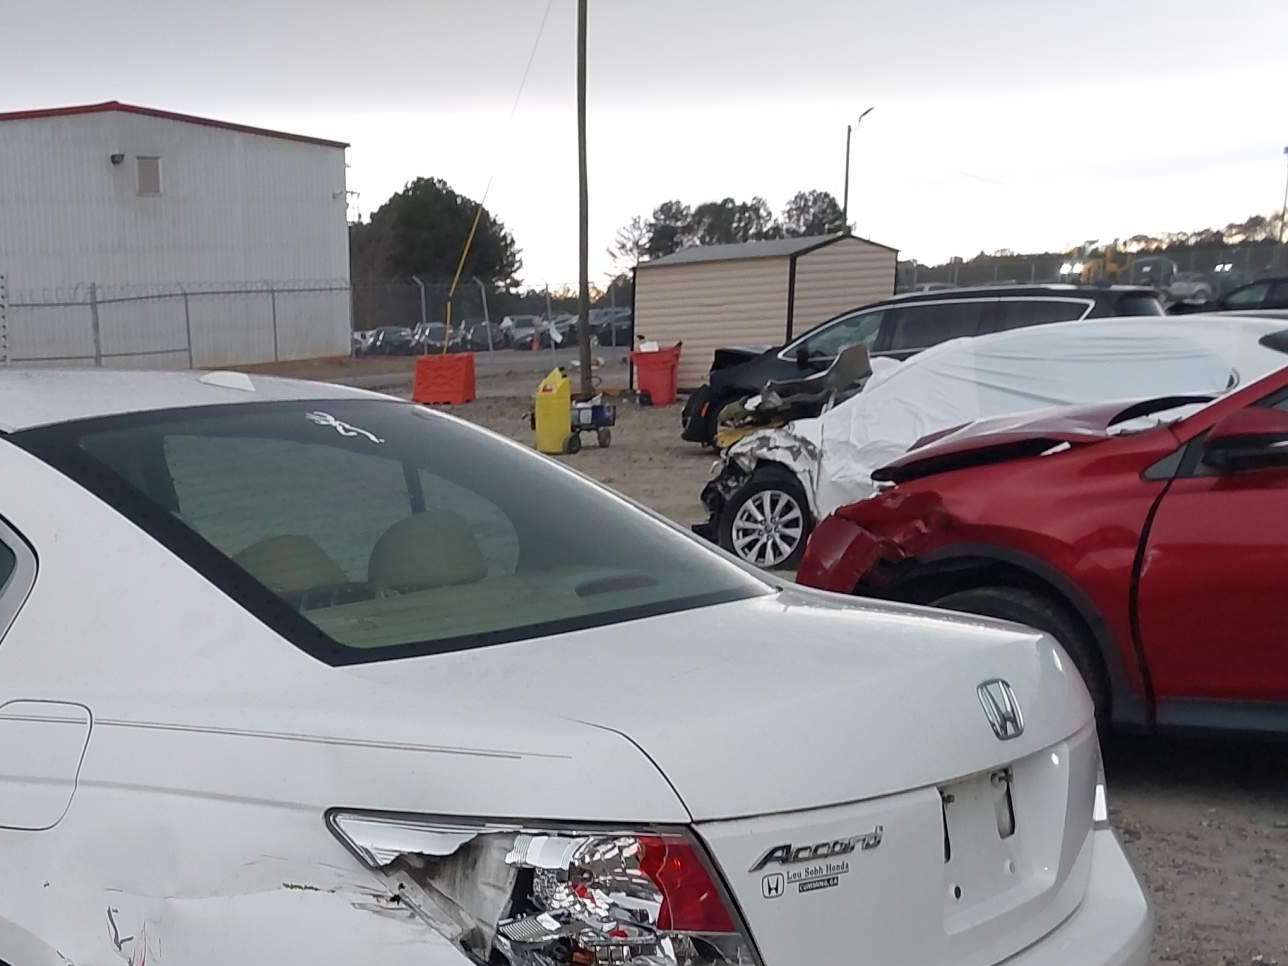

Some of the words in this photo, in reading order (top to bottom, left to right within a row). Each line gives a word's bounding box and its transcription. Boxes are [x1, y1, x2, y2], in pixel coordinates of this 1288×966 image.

[748, 826, 883, 872] Accord
[787, 870, 802, 881] Lou
[826, 860, 849, 874] Honda
